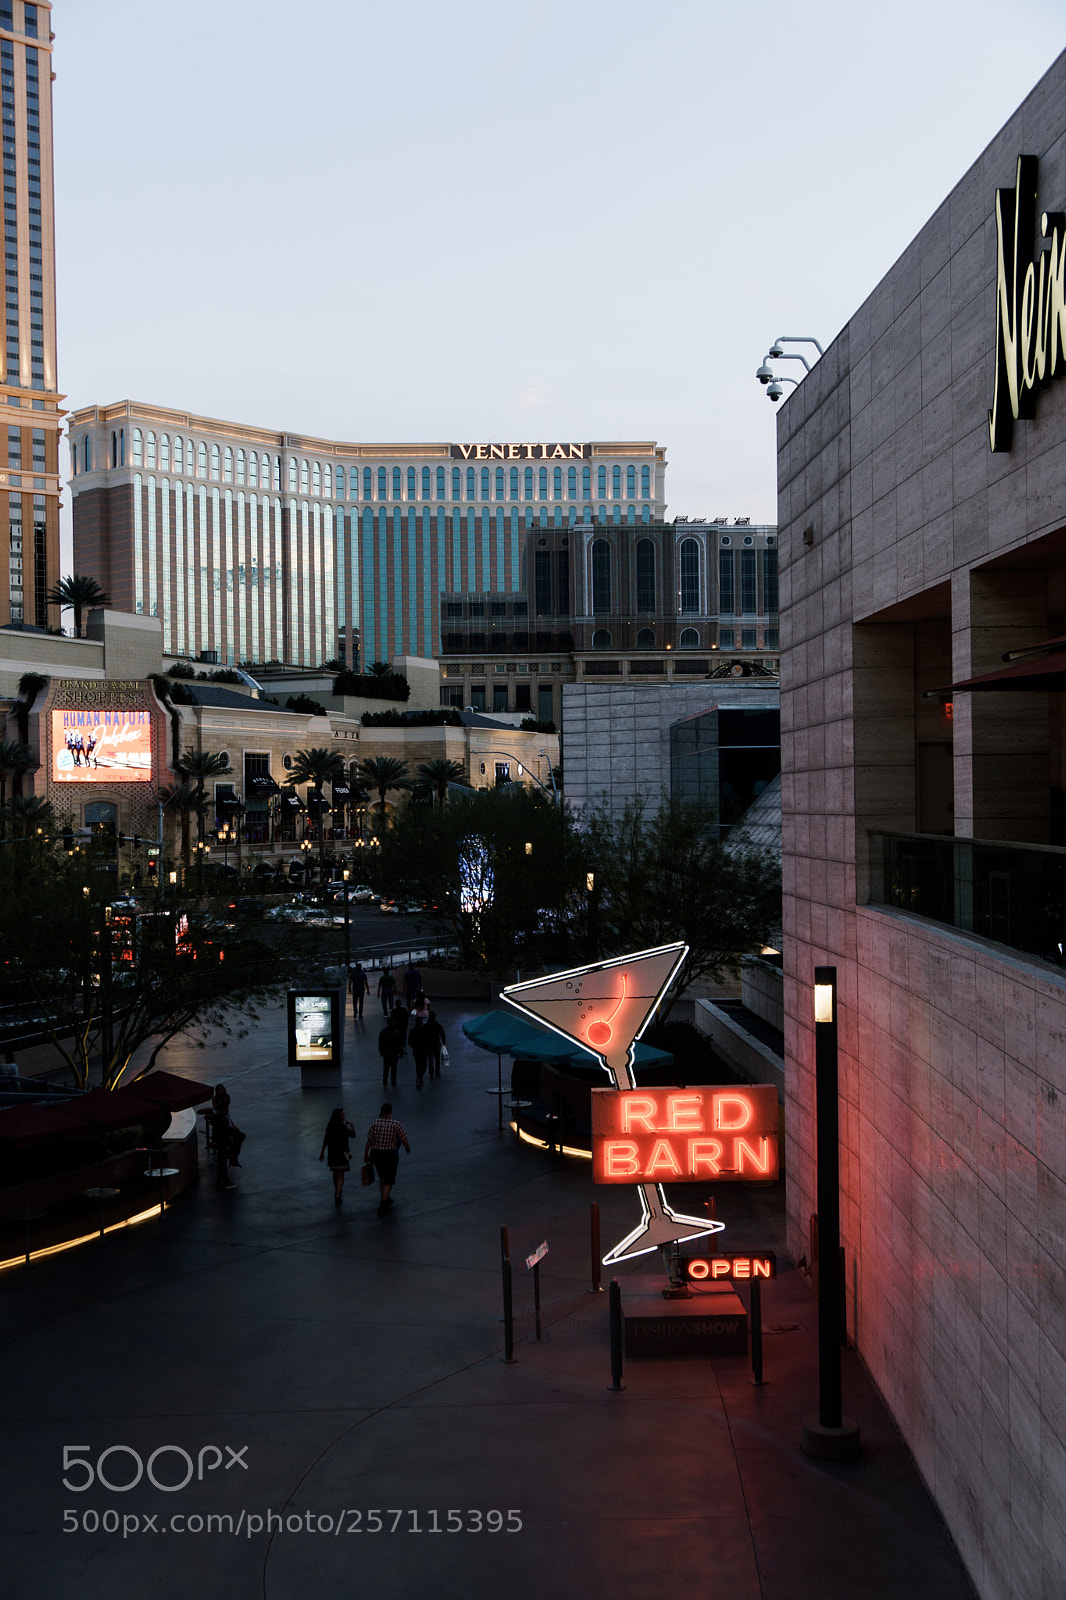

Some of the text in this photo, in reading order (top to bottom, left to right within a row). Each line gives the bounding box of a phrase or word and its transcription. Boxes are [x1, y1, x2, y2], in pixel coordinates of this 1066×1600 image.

[457, 443, 585, 460] VENETIAN
[58, 680, 140, 691] GRAND CANAL
[65, 690, 138, 704] SHOPPES
[63, 712, 100, 726] HUMAN
[620, 1093, 753, 1134] RED
[603, 1136, 770, 1178] BARN
[688, 1259, 771, 1279] OPEN
